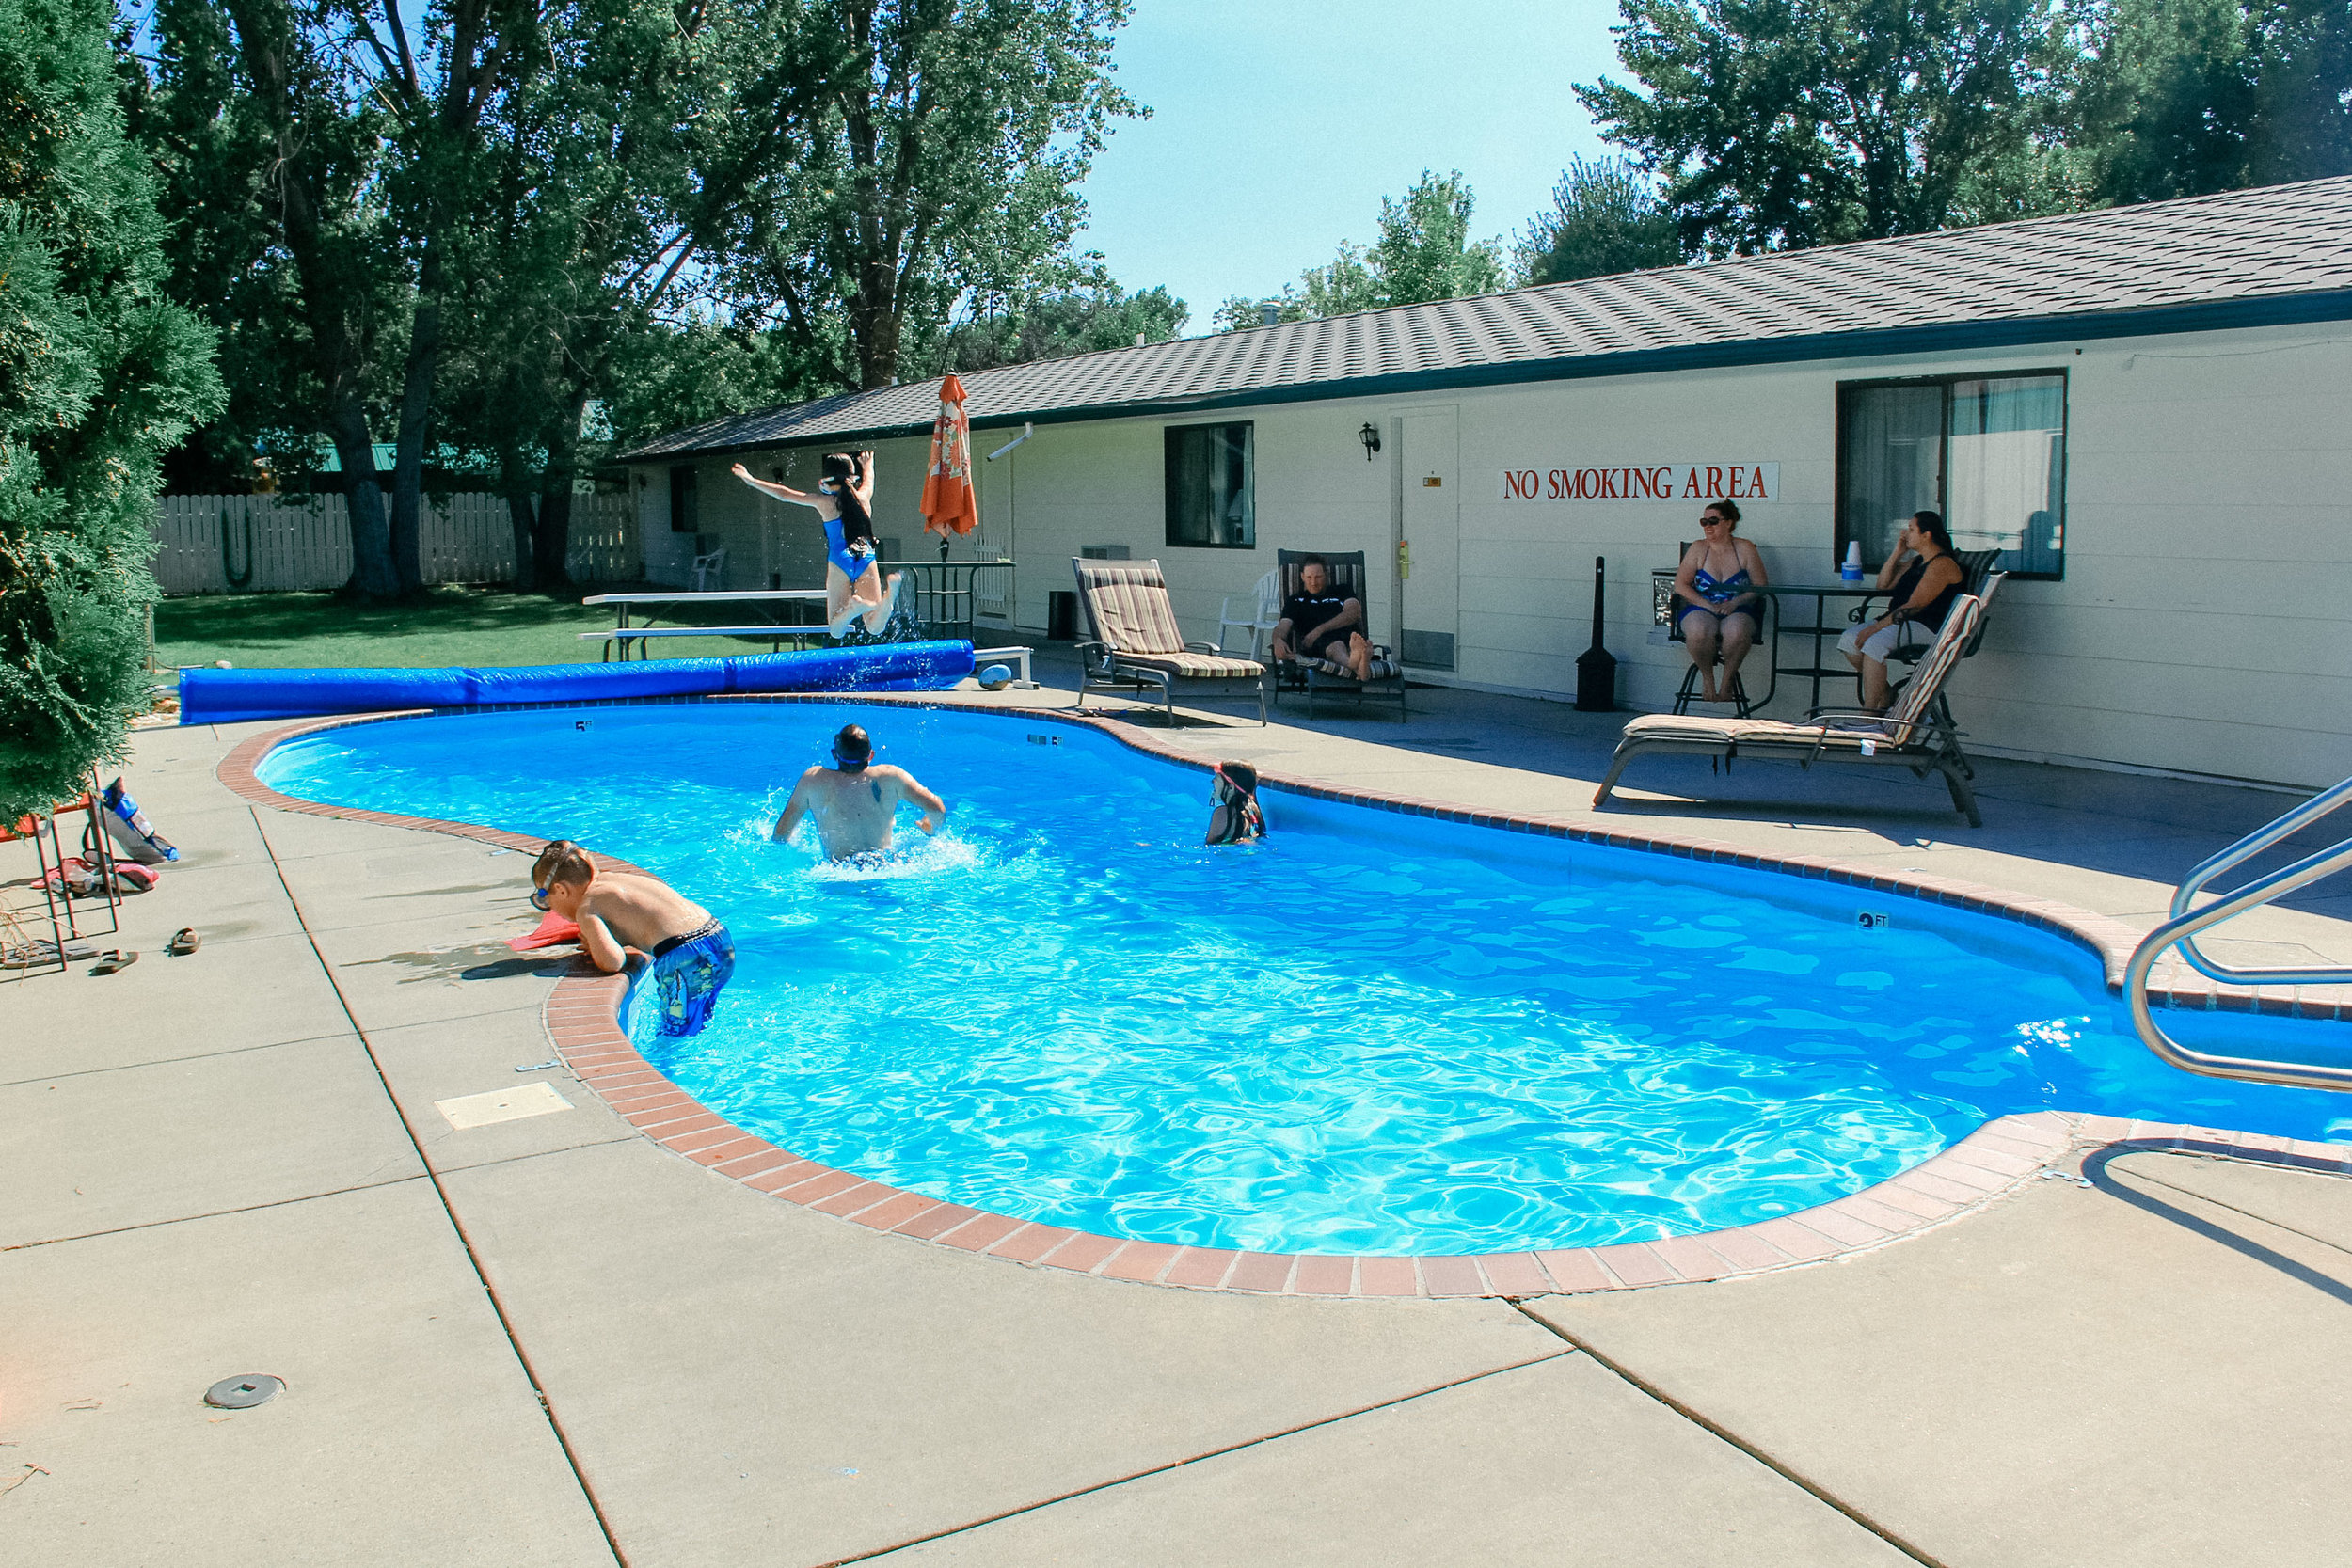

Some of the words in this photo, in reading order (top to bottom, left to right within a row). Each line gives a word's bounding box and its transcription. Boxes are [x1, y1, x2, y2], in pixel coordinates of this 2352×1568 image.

[1503, 469, 1540, 499] NO
[1547, 467, 1673, 499] SMOKING
[1681, 466, 1768, 499] AREA
[1875, 914, 1887, 927] FT
